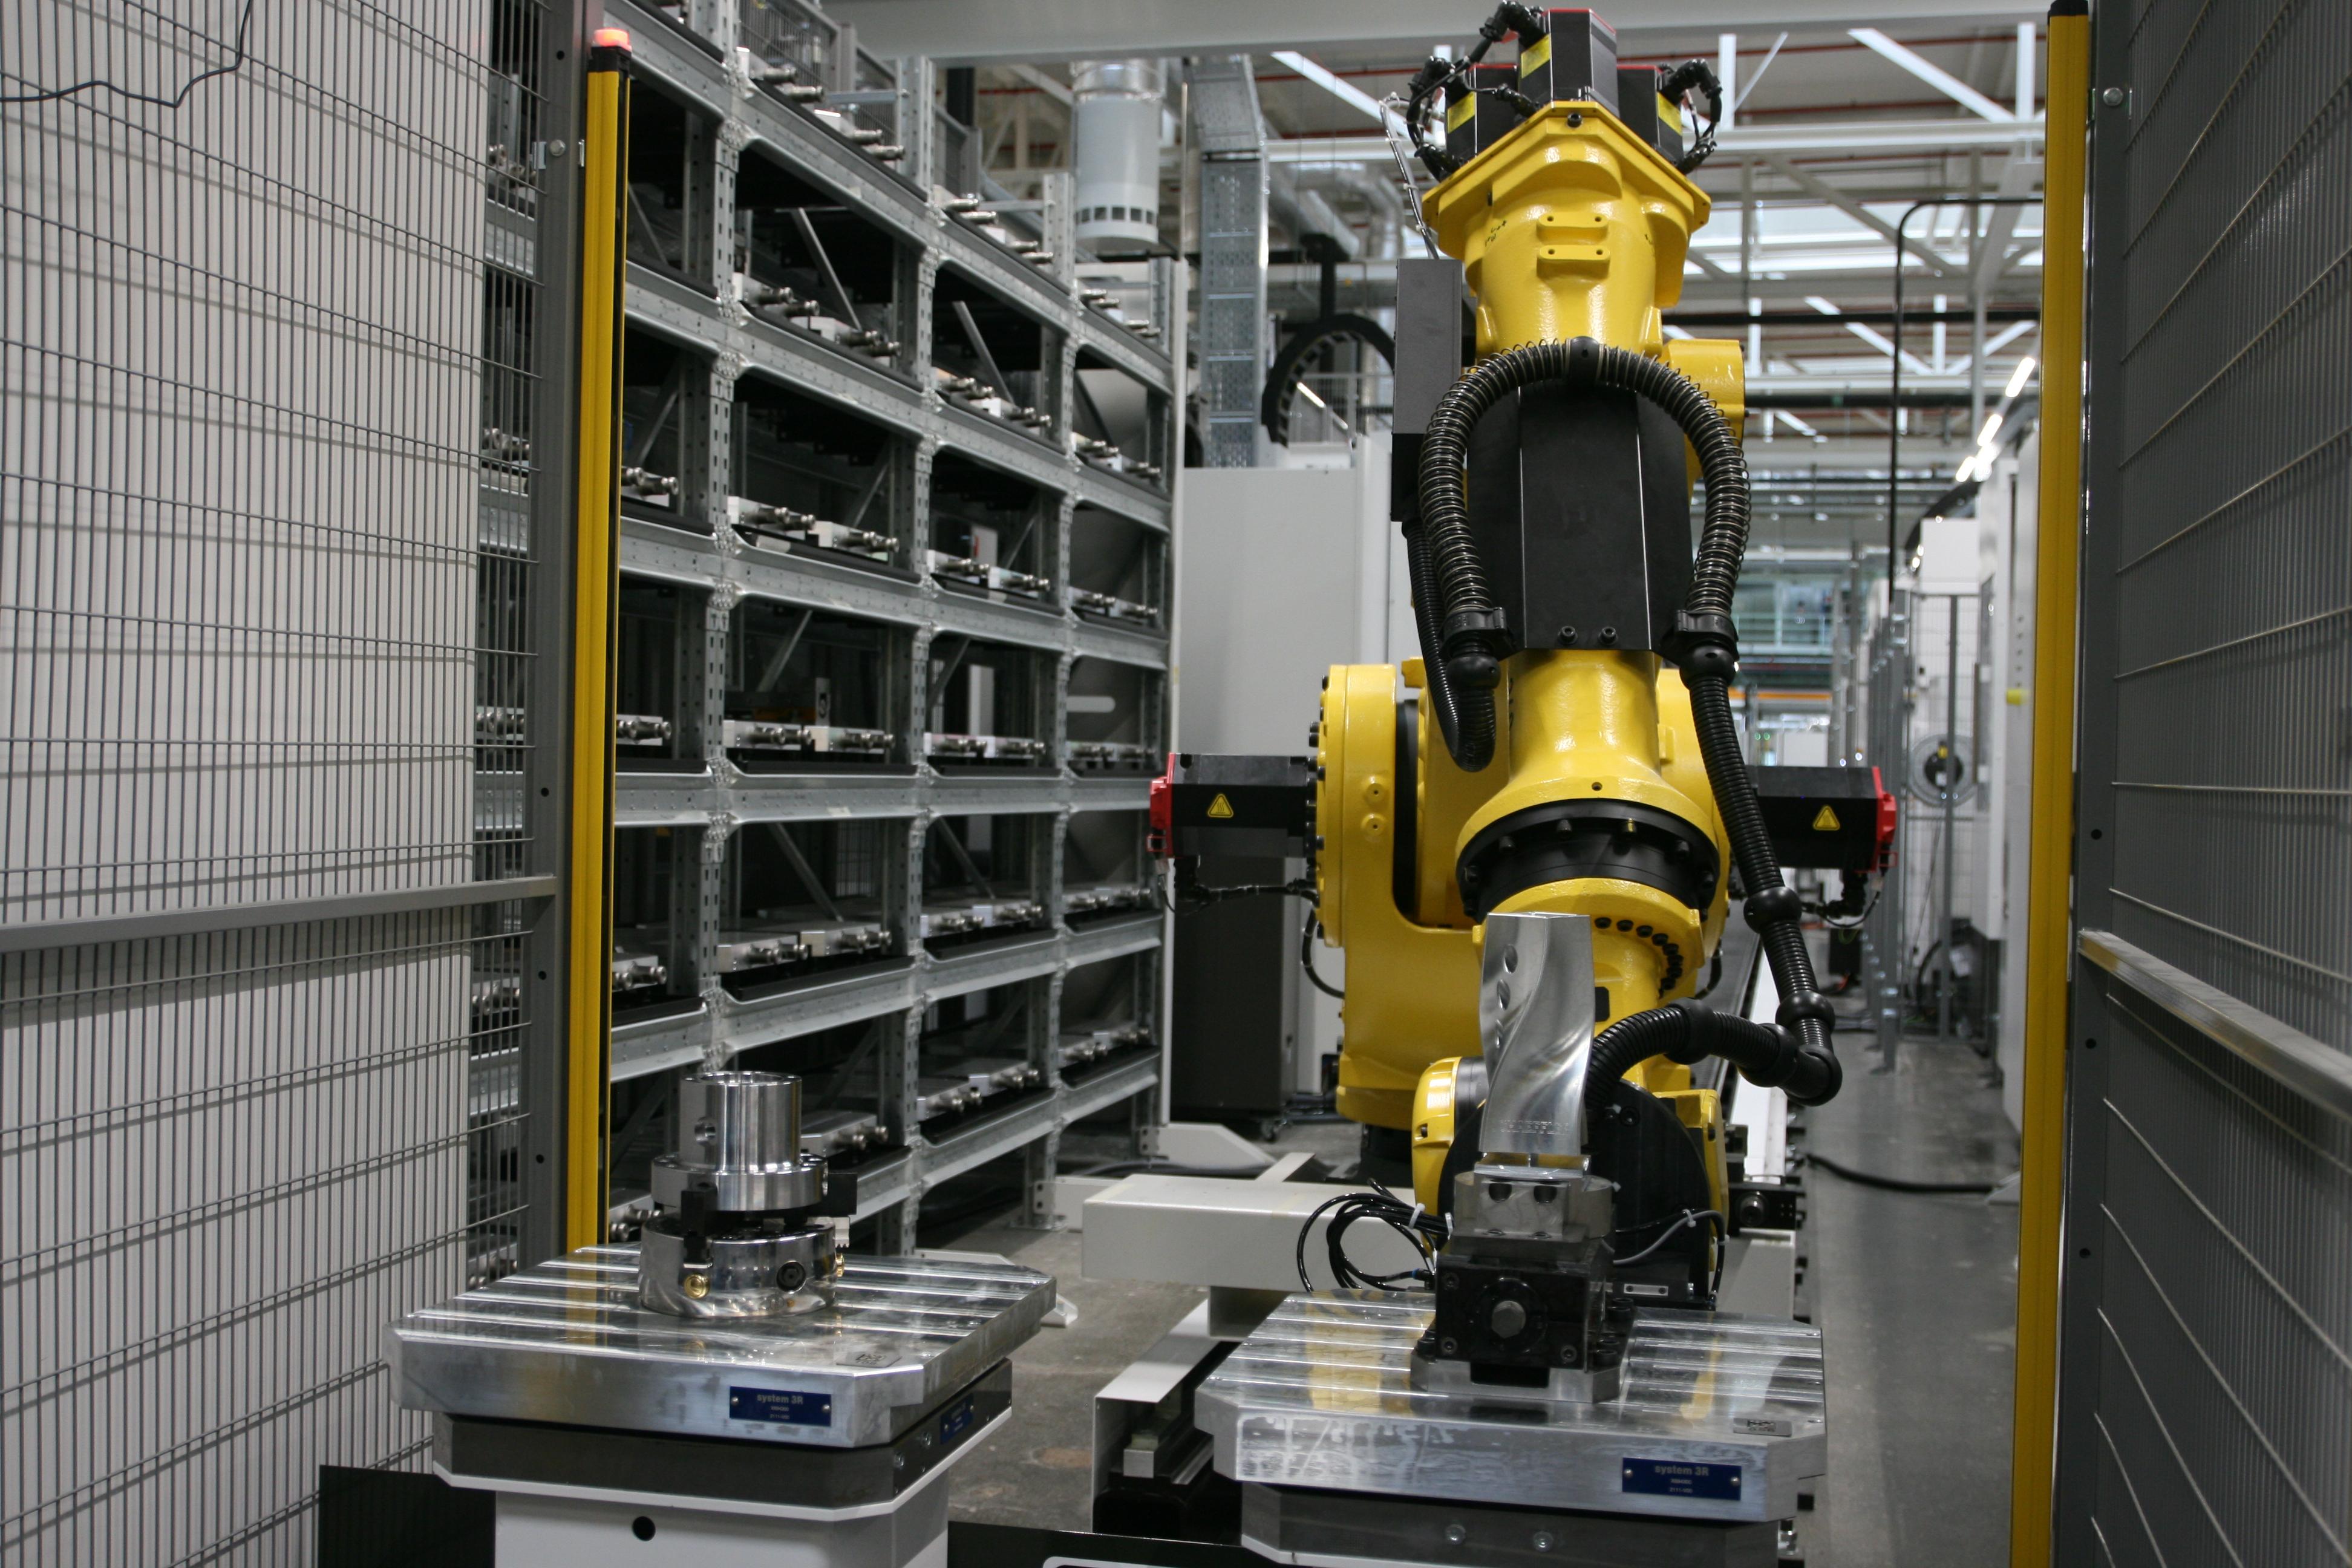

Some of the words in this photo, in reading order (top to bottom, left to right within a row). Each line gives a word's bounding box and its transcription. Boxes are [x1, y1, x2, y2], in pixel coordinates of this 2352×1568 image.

[756, 1394, 789, 1403] system
[791, 1395, 804, 1405] 3R
[1655, 1465, 1693, 1475] system
[1694, 1466, 1710, 1476] 3R
